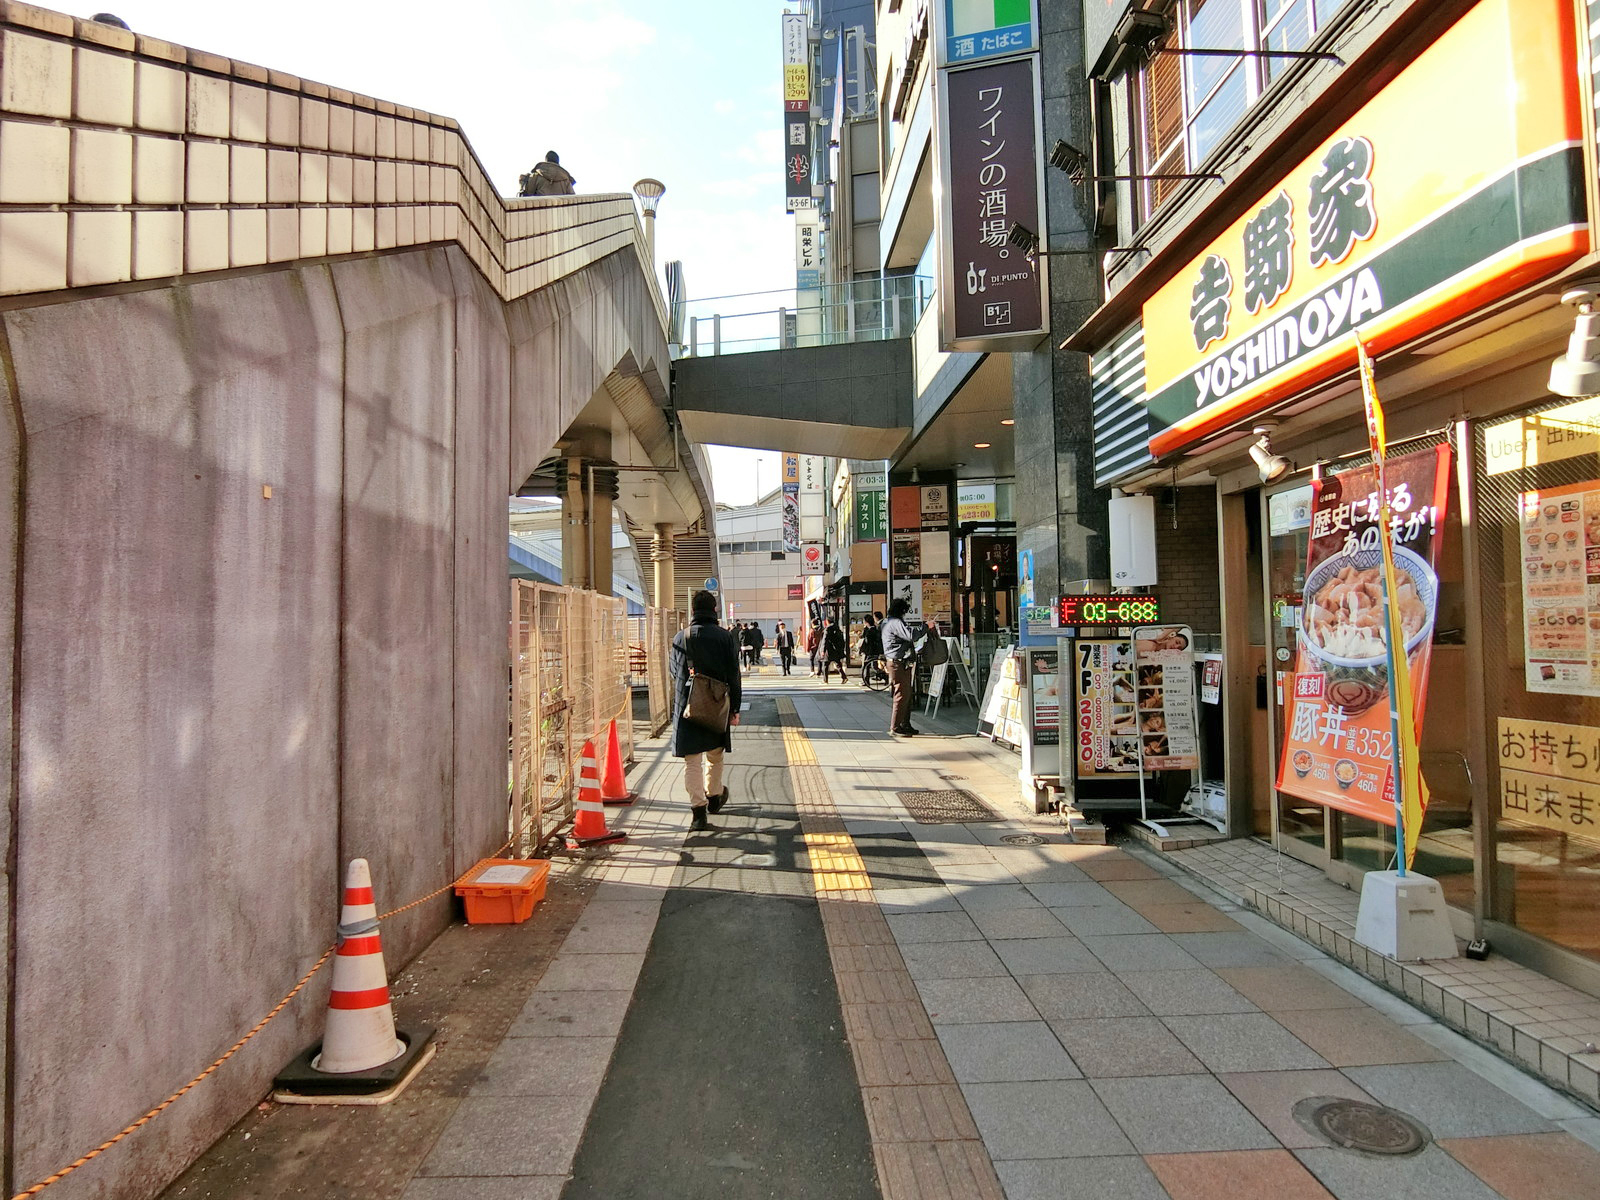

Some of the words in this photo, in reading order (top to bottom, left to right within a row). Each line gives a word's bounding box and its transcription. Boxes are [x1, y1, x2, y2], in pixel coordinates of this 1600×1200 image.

[789, 24, 797, 64] ミライザカ
[955, 37, 975, 57] 酒
[981, 31, 1023, 51] たばこ
[802, 228, 812, 267] 昭栄ビル
[1002, 272, 1028, 282] PUNTO
[987, 306, 1000, 316] B1
[786, 456, 797, 478] 松屋
[860, 493, 869, 532] アカスリ
[1312, 483, 1413, 540] 歴史に残る
[1297, 677, 1321, 695] 復刻
[1291, 701, 1348, 750] 豚丼
[1356, 727, 1393, 760] 352
[1501, 726, 1600, 773] お持ち
[1504, 779, 1600, 826] 出来ま
